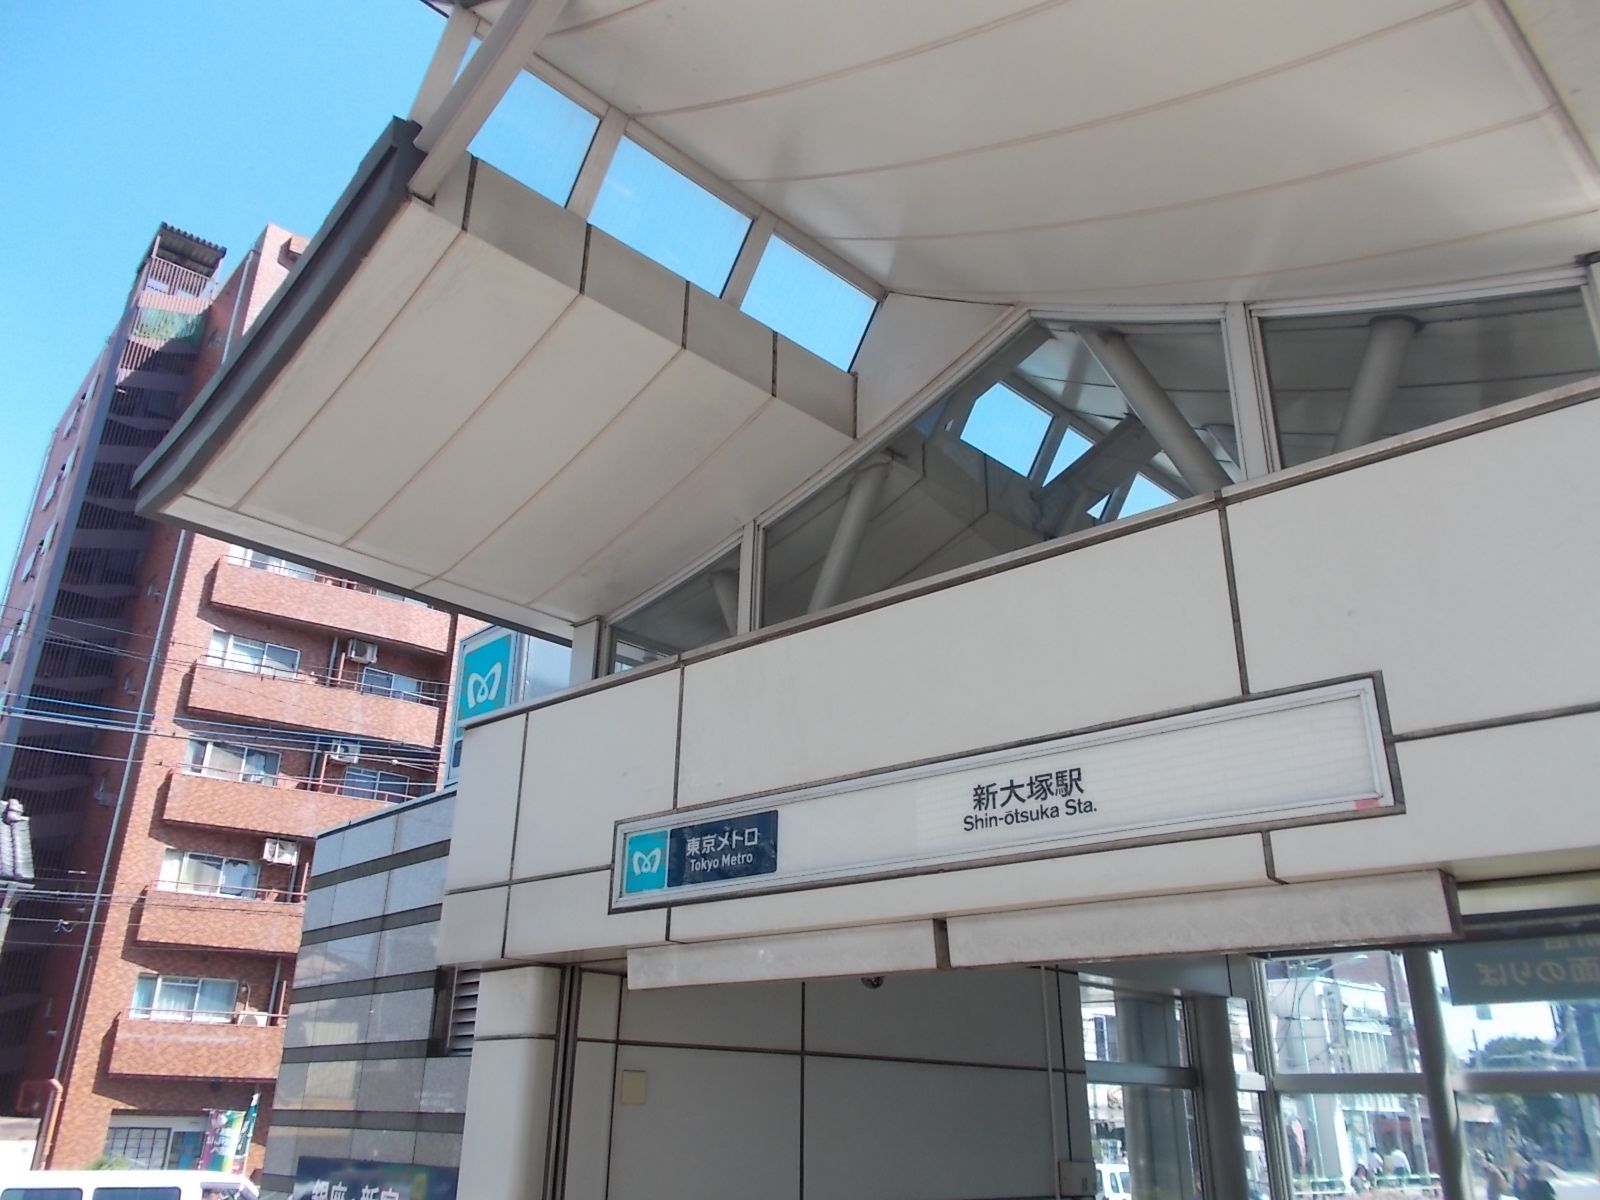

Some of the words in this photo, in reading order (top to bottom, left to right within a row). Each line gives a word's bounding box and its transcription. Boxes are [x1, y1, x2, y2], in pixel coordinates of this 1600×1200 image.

[972, 767, 1085, 811] 新大塚駅
[1065, 798, 1098, 816] Sta.
[685, 827, 759, 857] 東京メトロ
[690, 858, 720, 873] Tokyo
[721, 852, 754, 867] Metro
